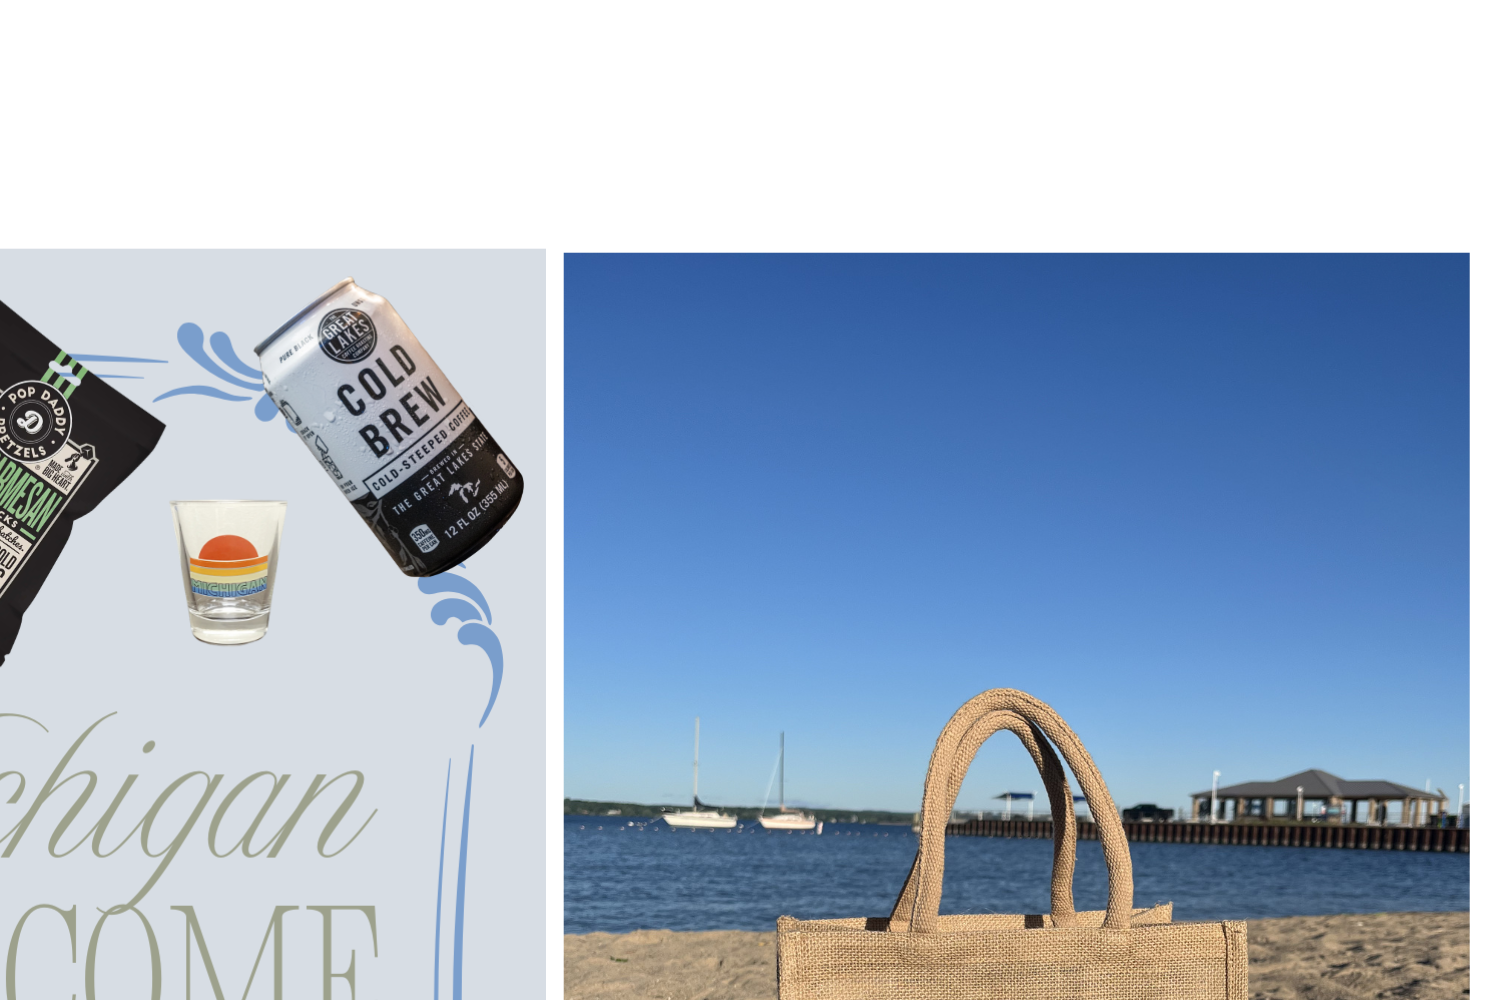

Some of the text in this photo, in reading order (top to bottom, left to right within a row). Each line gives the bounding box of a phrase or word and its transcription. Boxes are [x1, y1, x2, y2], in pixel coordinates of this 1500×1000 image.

[323, 312, 358, 340] GREAT
[328, 319, 370, 354] LAKES
[336, 344, 417, 417] COLD
[8, 386, 67, 436] POP DADDY
[358, 375, 447, 460] BREW
[372, 429, 448, 491] COLD-STEEPED
[392, 449, 474, 516] THE GREAT LAKES
[191, 576, 267, 598] MICHIGAN
